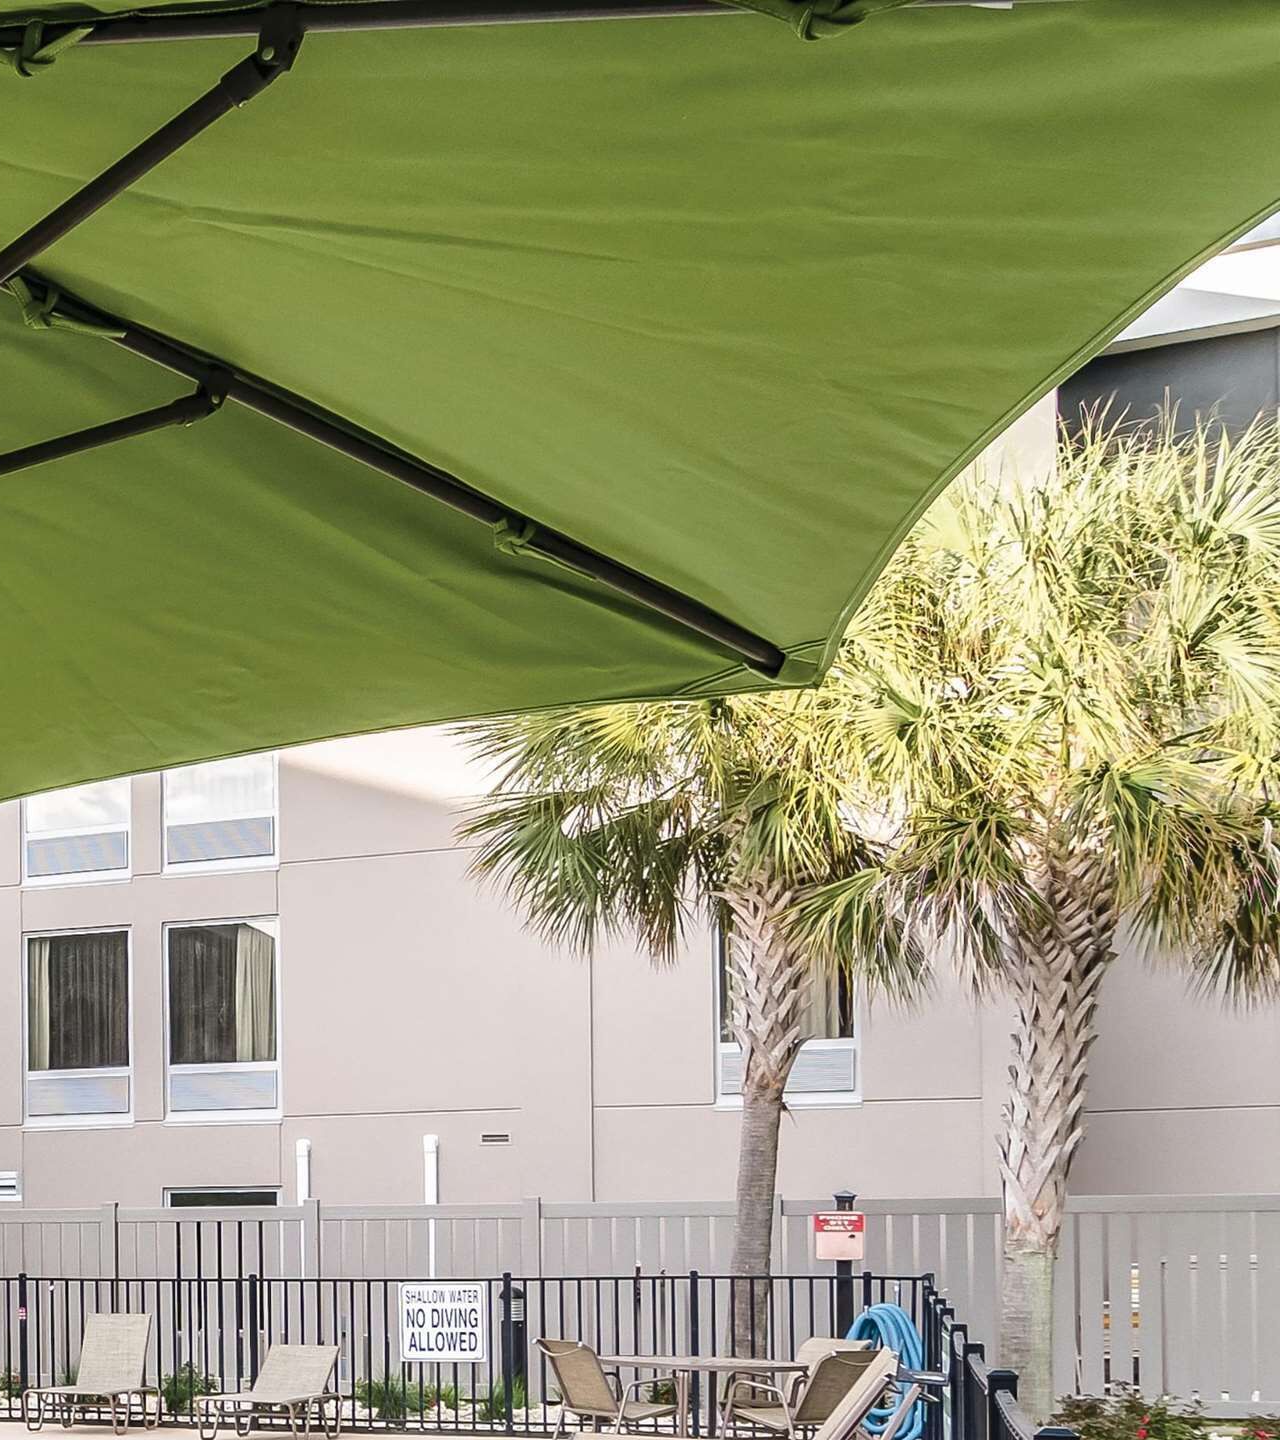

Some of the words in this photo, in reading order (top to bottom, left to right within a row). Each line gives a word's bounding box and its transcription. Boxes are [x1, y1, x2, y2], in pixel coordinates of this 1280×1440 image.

[404, 1289, 446, 1305] SHALLOW
[449, 1289, 480, 1305] WATER
[406, 1307, 426, 1329] NO
[430, 1307, 480, 1329] DIVING
[408, 1331, 479, 1353] ALLOWED
